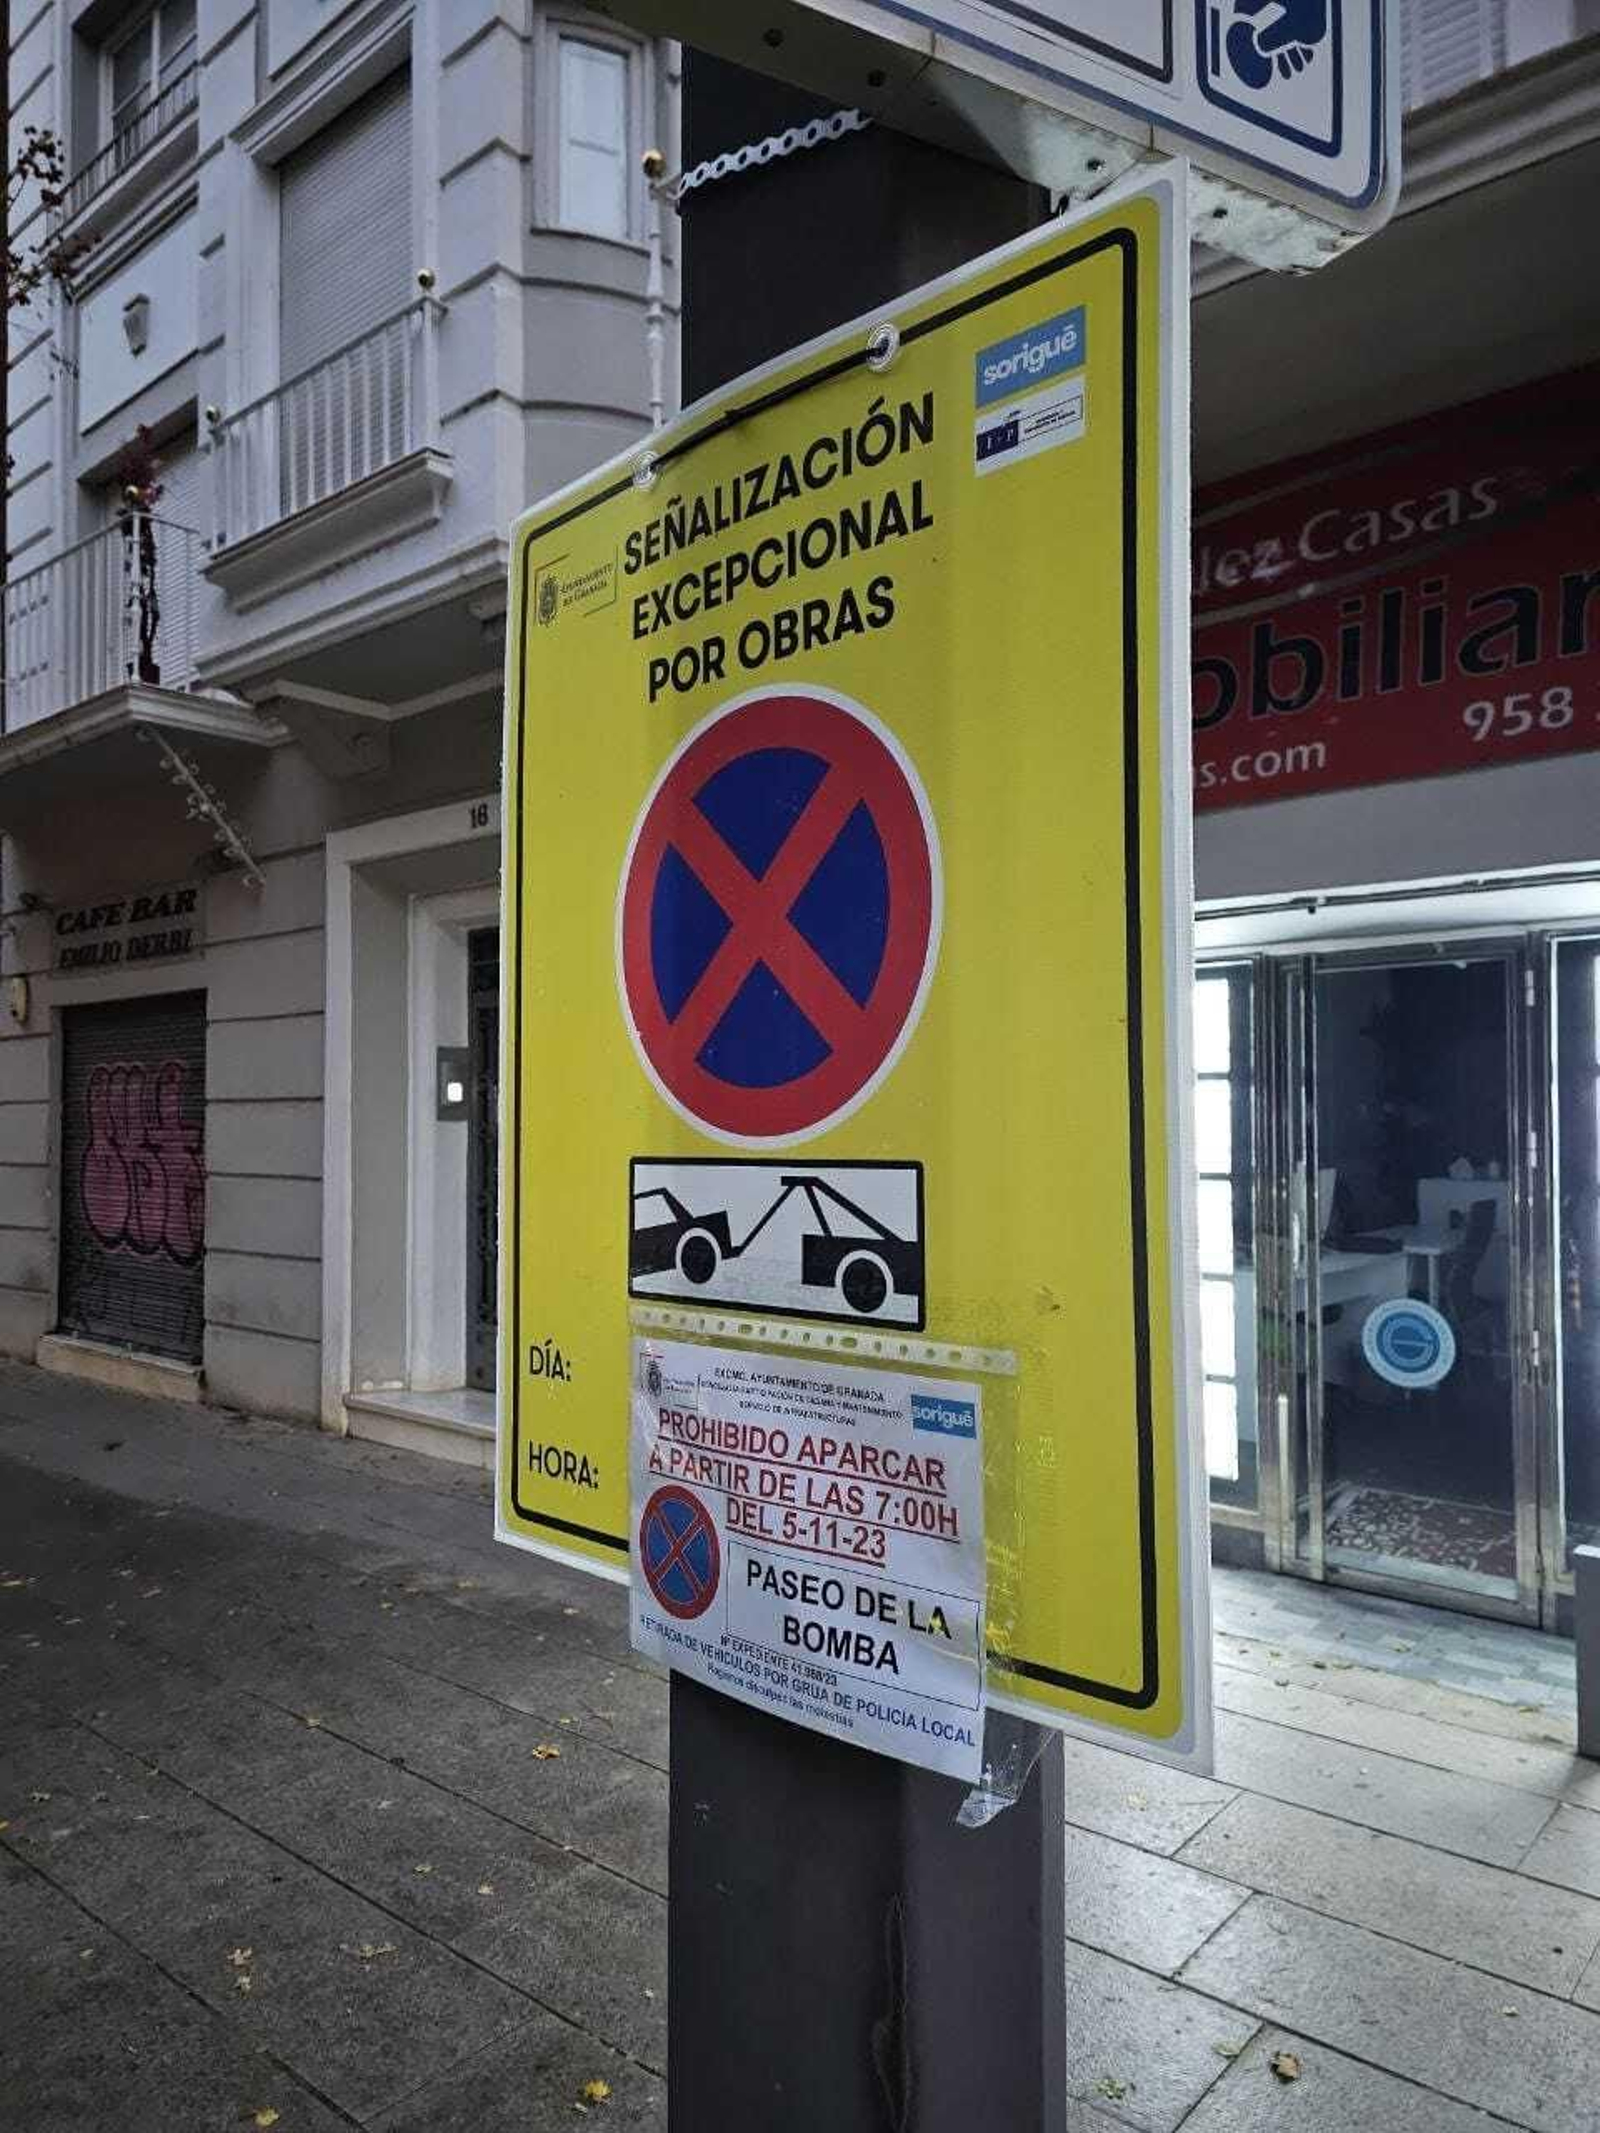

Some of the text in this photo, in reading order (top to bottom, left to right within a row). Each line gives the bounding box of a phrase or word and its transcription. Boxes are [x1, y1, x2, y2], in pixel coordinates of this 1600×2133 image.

[624, 392, 935, 577] SEÑALIZACIÓN
[1298, 477, 1500, 562] Casas
[632, 479, 935, 640] EXCEPCIONAL
[648, 575, 896, 703] POR OBRAS
[1192, 686, 1574, 789] s.com 958
[129, 889, 198, 923] BAR
[529, 1338, 571, 1382] DÍA:
[750, 1373, 822, 1392] AYUNTAMIENTO
[822, 1383, 834, 1394] DE
[836, 1385, 885, 1402] GRANADA
[529, 1439, 599, 1489] HORA:
[659, 1407, 947, 1490] PROHIBIDO APARCAR
[650, 1444, 959, 1537] A PARTIR DE LAS 7:00H
[727, 1497, 886, 1558] DEL 5-11-23
[747, 1559, 952, 1640] PASEO DE LA
[732, 1640, 790, 1671] EXPEDIENTE
[783, 1615, 899, 1675] BOMBA
[682, 1634, 698, 1652] DE
[764, 1667, 790, 1690] POR
[833, 1691, 856, 1711] DE
[922, 1717, 976, 1747] LOCAL
